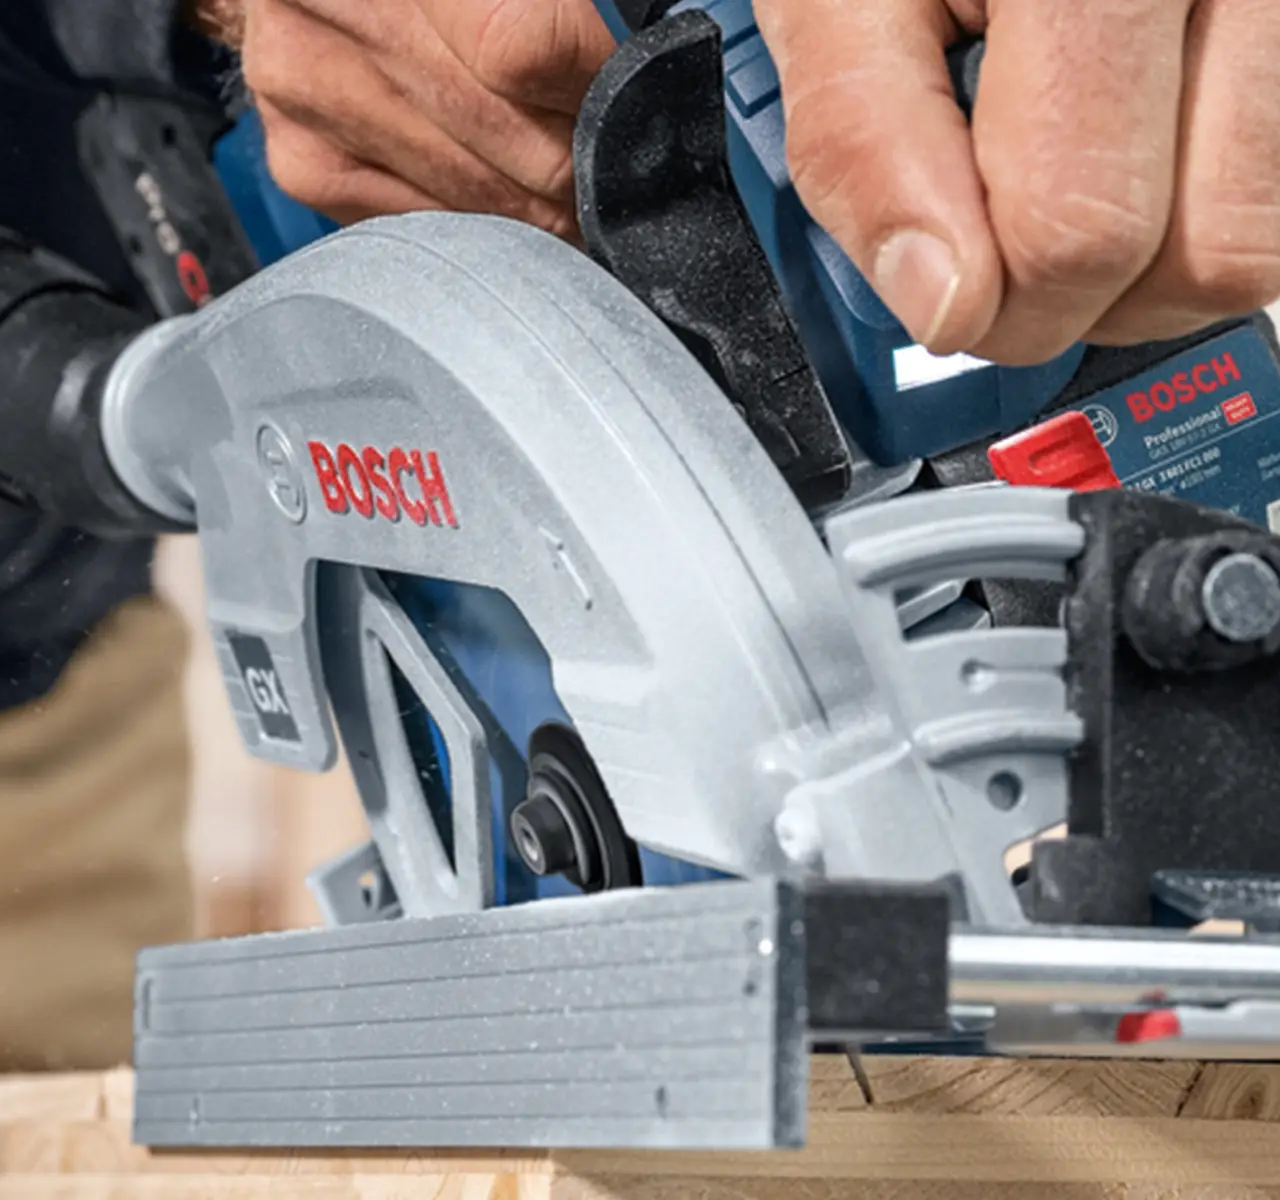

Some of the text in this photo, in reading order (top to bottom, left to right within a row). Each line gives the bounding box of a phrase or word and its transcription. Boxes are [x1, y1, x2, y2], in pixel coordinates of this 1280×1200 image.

[1125, 352, 1242, 423] BOSCH
[1143, 404, 1222, 449] Professional
[308, 441, 459, 528] BOSCH
[246, 666, 290, 715] GX
